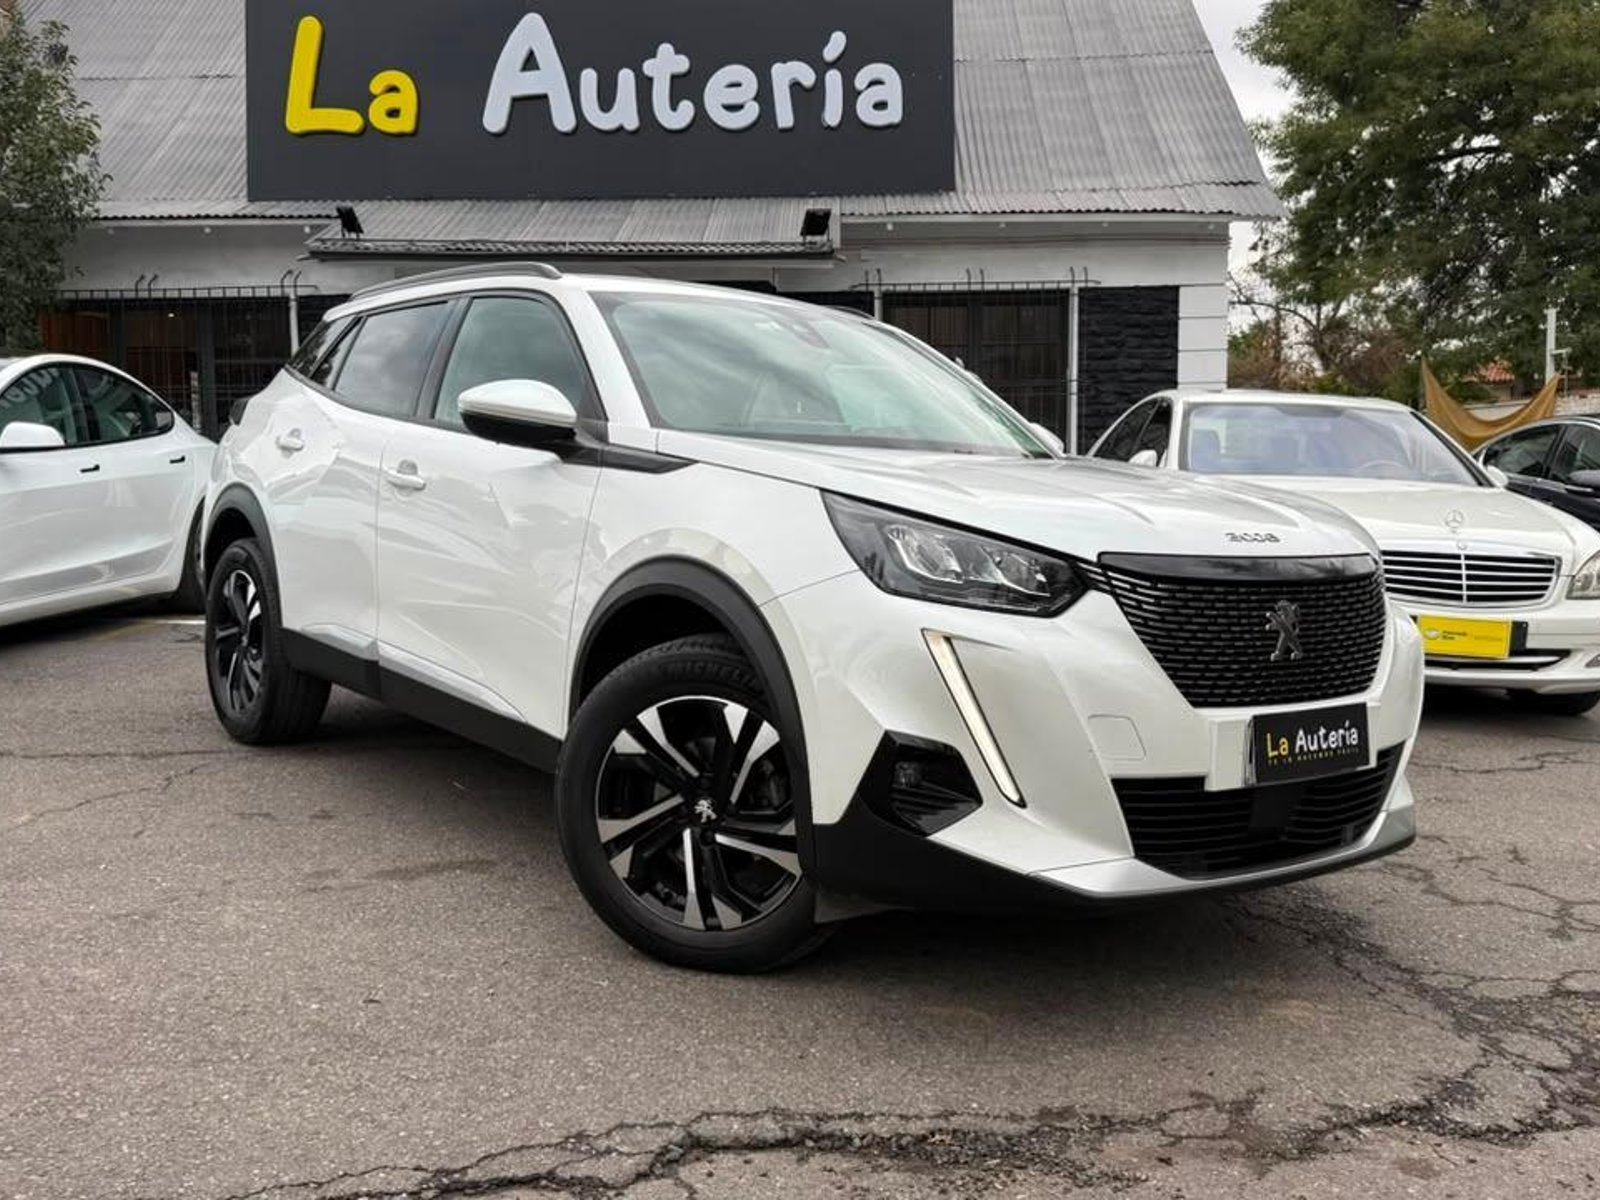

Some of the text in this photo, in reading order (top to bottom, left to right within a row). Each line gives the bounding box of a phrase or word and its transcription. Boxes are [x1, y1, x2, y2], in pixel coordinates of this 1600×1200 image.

[286, 12, 904, 134] La Autería
[1225, 532, 1280, 543] 2008
[1266, 732, 1289, 758] La
[1295, 719, 1358, 754] Autería
